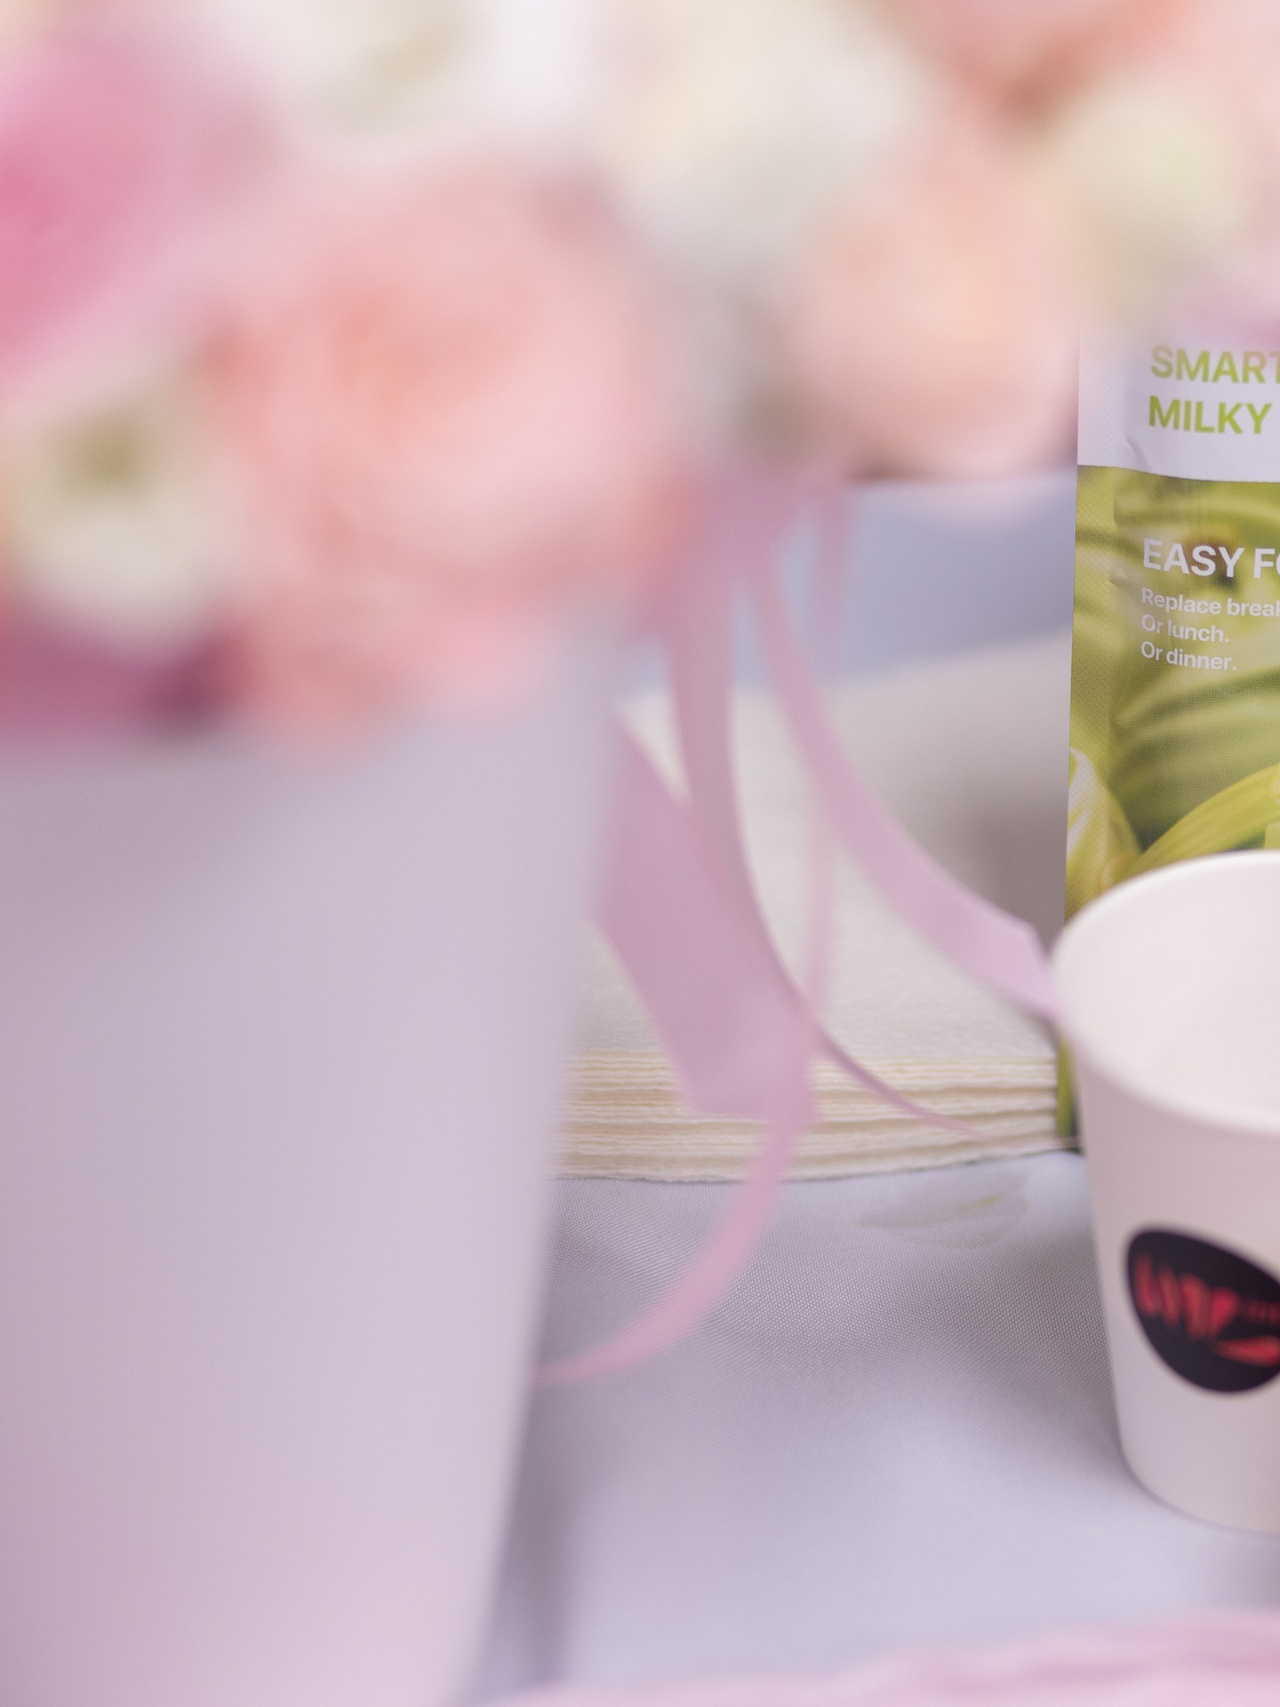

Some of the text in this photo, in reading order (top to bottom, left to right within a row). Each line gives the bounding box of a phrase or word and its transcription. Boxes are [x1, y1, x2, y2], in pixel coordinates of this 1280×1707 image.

[1149, 395, 1272, 434] MILKY
[1143, 538, 1245, 578] EASY
[1141, 587, 1222, 615] Replace
[1141, 614, 1230, 643] Or lunch.
[1140, 641, 1237, 671] Or dinner.
